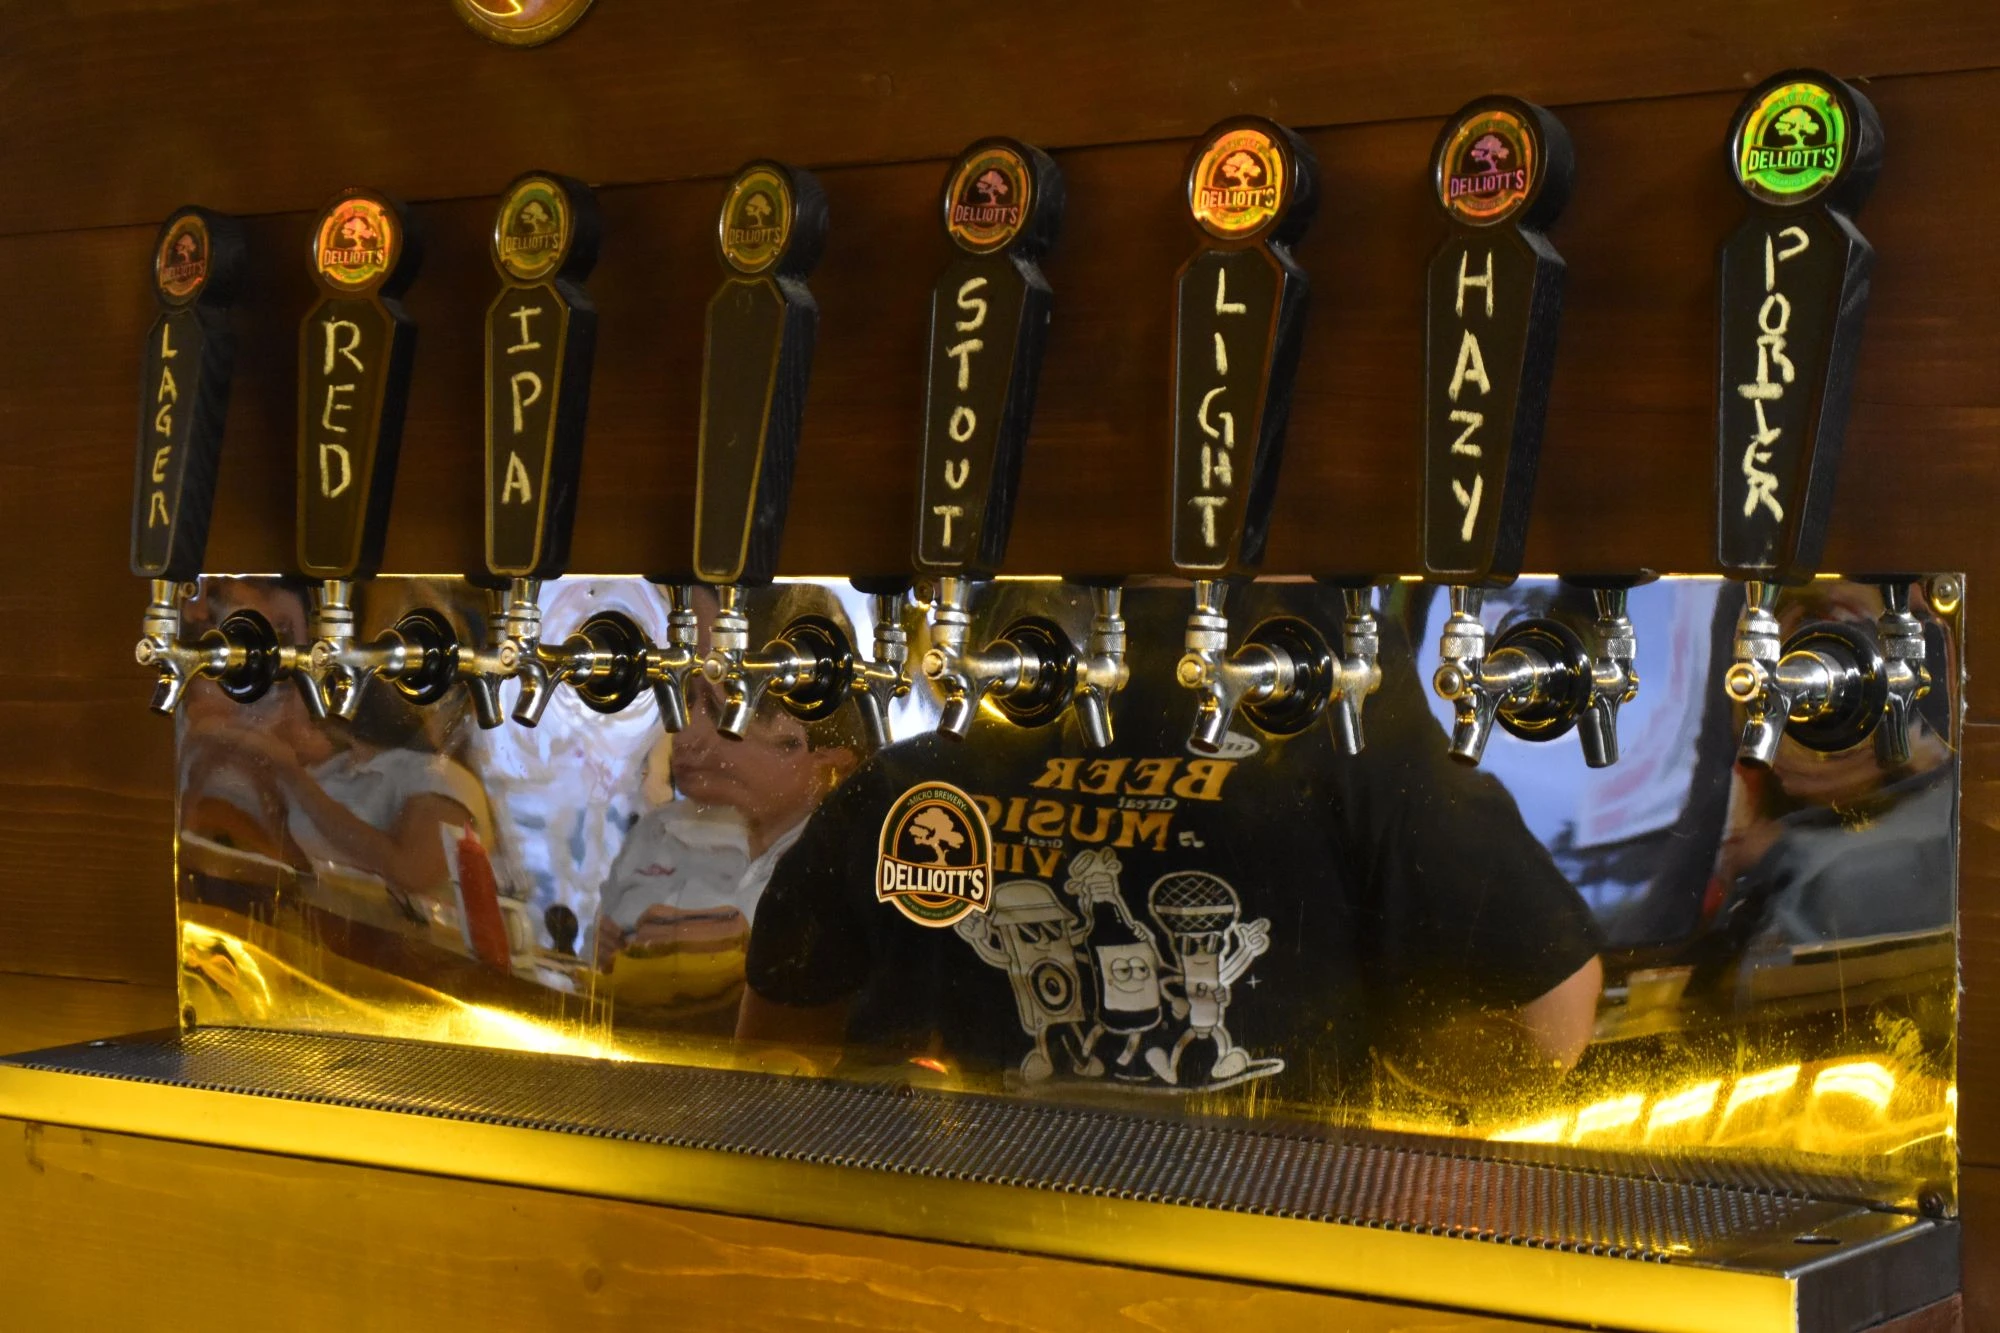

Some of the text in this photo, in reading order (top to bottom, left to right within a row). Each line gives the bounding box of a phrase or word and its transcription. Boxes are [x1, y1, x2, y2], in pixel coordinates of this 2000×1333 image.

[954, 205, 1018, 225] DELLIOTT'S
[1200, 188, 1275, 208] DELLIOTT'S
[1450, 169, 1525, 198] DELLIOTT'S
[1748, 147, 1835, 171] DELLIOTT'S
[323, 249, 384, 266] DELLIOTT'S
[148, 323, 178, 529] LAGER
[319, 316, 364, 499] RED
[501, 306, 542, 505] IPA
[933, 277, 988, 547] STOUT
[1188, 267, 1247, 547] LIGHT
[1448, 250, 1495, 542] HAZY
[1738, 226, 1810, 523] PORTER
[934, 790, 966, 810] BREWERY
[882, 859, 985, 901] DELLIOTT'S
